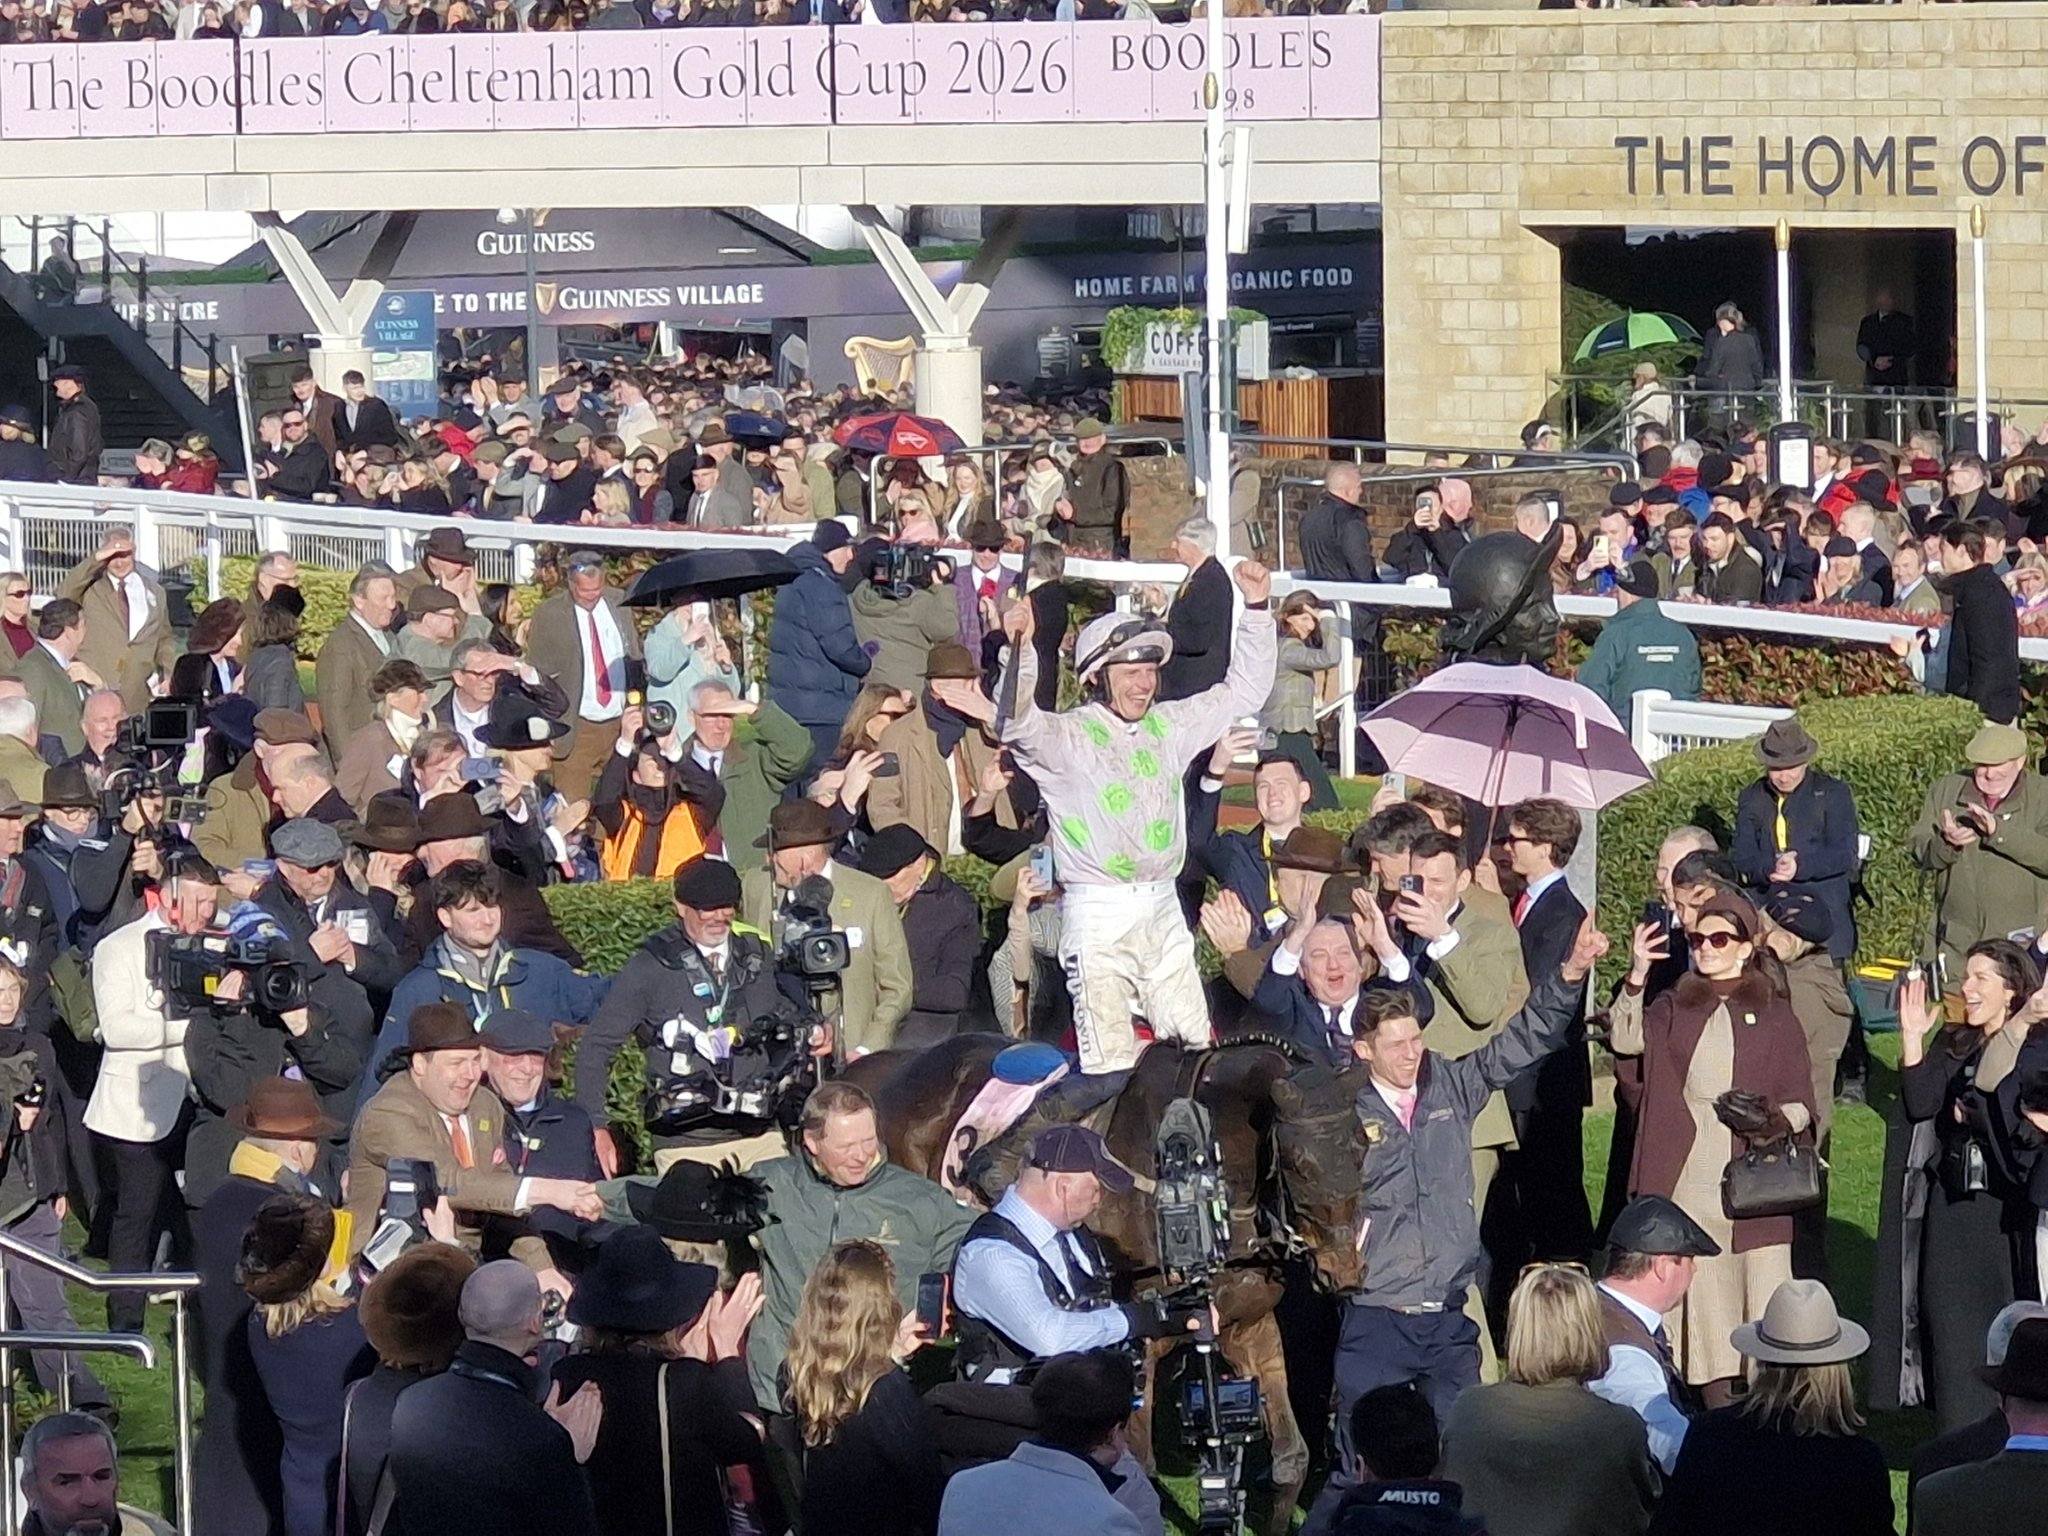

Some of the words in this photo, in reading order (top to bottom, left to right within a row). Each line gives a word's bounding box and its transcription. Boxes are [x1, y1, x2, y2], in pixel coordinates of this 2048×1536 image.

[1111, 30, 1332, 71] BOODLES
[12, 57, 103, 111] The
[124, 49, 323, 109] Boodles
[344, 44, 653, 106] Cheltenham
[673, 38, 796, 99] Gold
[816, 42, 926, 117] Cup
[948, 38, 1067, 95] 2026
[1193, 88, 1255, 110] 198
[1614, 136, 1733, 195] THE
[1758, 136, 1938, 196] HOME
[1961, 136, 2046, 196] OF
[1075, 277, 1133, 297] HOME
[1140, 275, 1195, 294] FARM
[1203, 269, 1293, 291] GANIC
[1301, 268, 1353, 288] FOOD
[452, 294, 479, 312] TO
[486, 292, 527, 312] THE
[558, 287, 671, 311] GUINNESS
[676, 284, 764, 305] VILLAGE
[1151, 330, 1204, 355] COFF
[1378, 1490, 1440, 1505] MUSTO
